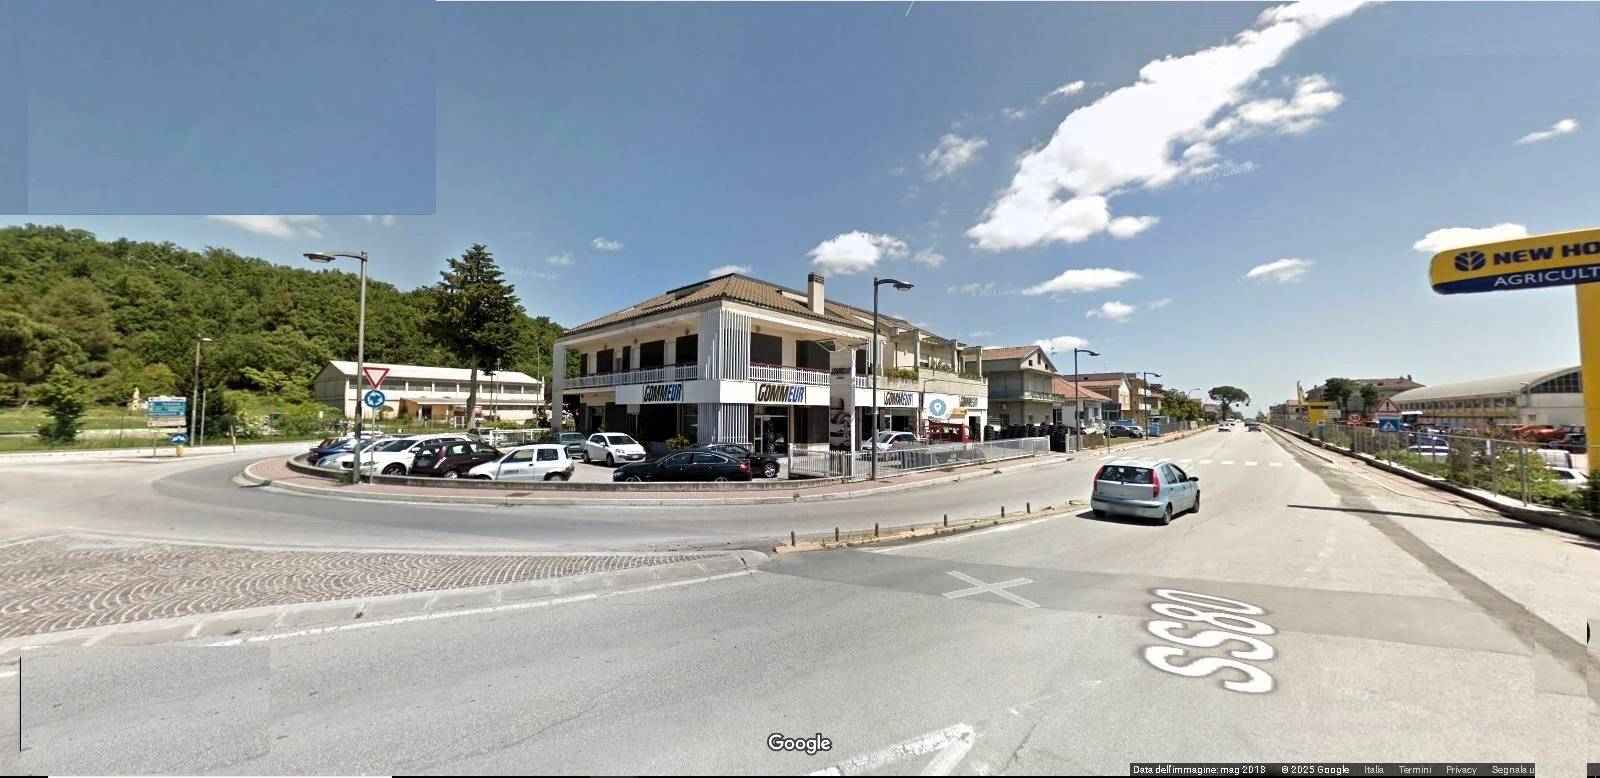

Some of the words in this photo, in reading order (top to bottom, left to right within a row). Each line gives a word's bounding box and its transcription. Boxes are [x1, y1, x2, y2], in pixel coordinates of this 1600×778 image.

[1493, 246, 1554, 265] NEW
[1561, 241, 1600, 258] HO
[1494, 266, 1600, 287] AGRICULT
[643, 383, 682, 402] GOMMEUR
[757, 383, 805, 403] GOMMEUR
